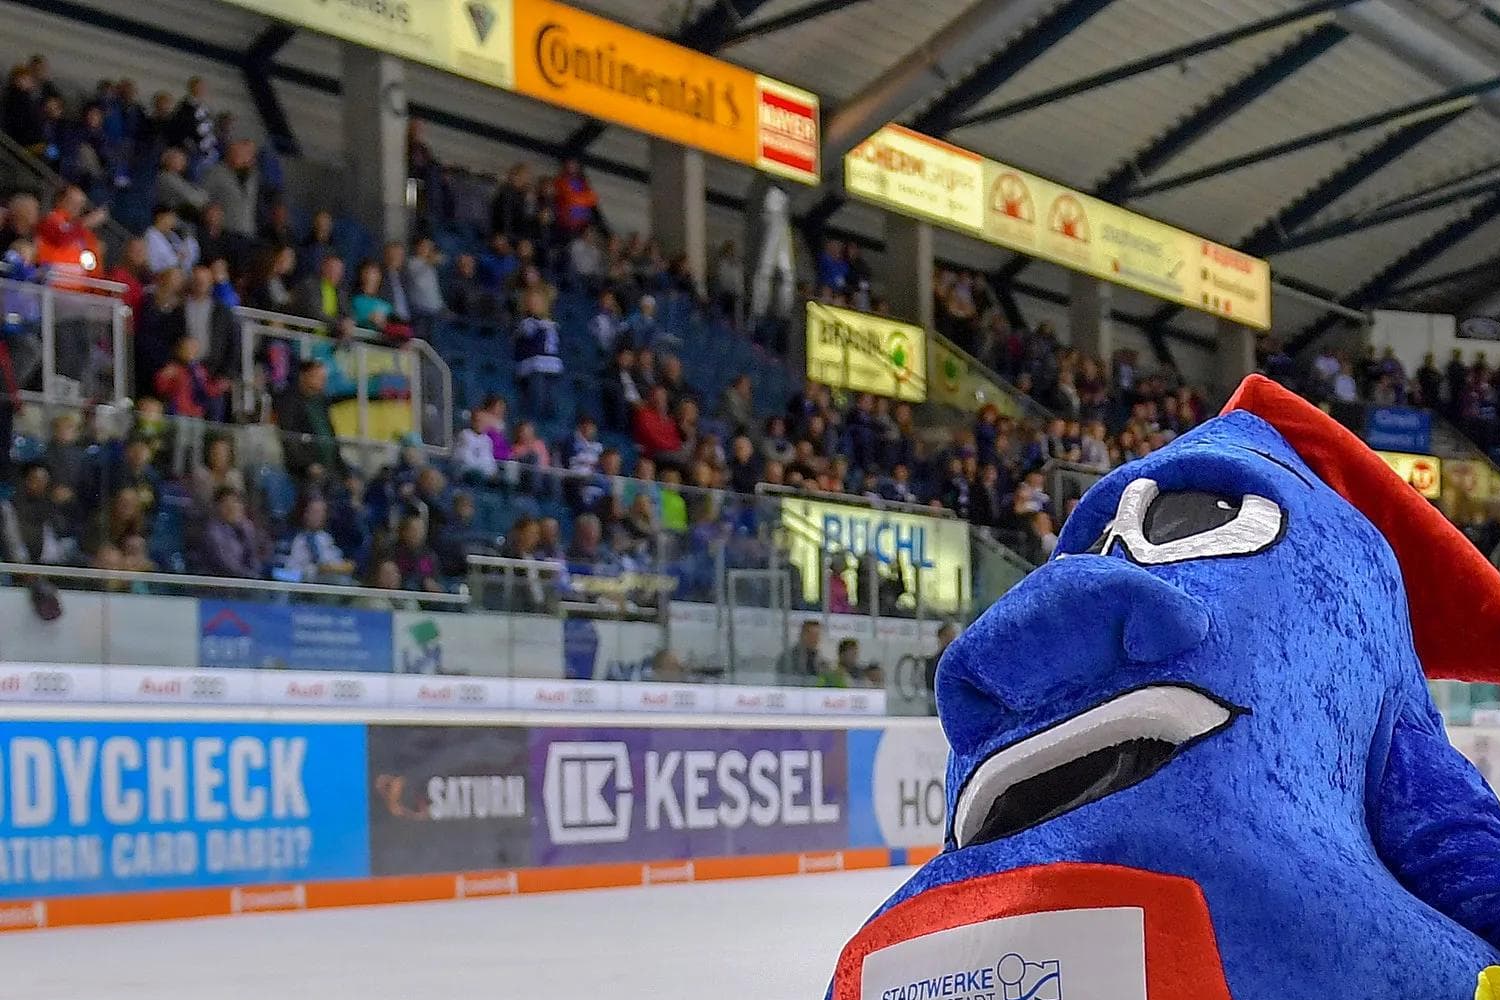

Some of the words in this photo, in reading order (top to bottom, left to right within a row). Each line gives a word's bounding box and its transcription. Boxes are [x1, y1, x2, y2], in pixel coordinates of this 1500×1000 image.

[536, 24, 716, 123] Continental
[0, 735, 310, 828] DYCHECK
[427, 775, 526, 821] SATURN
[645, 749, 841, 830] KESSEL
